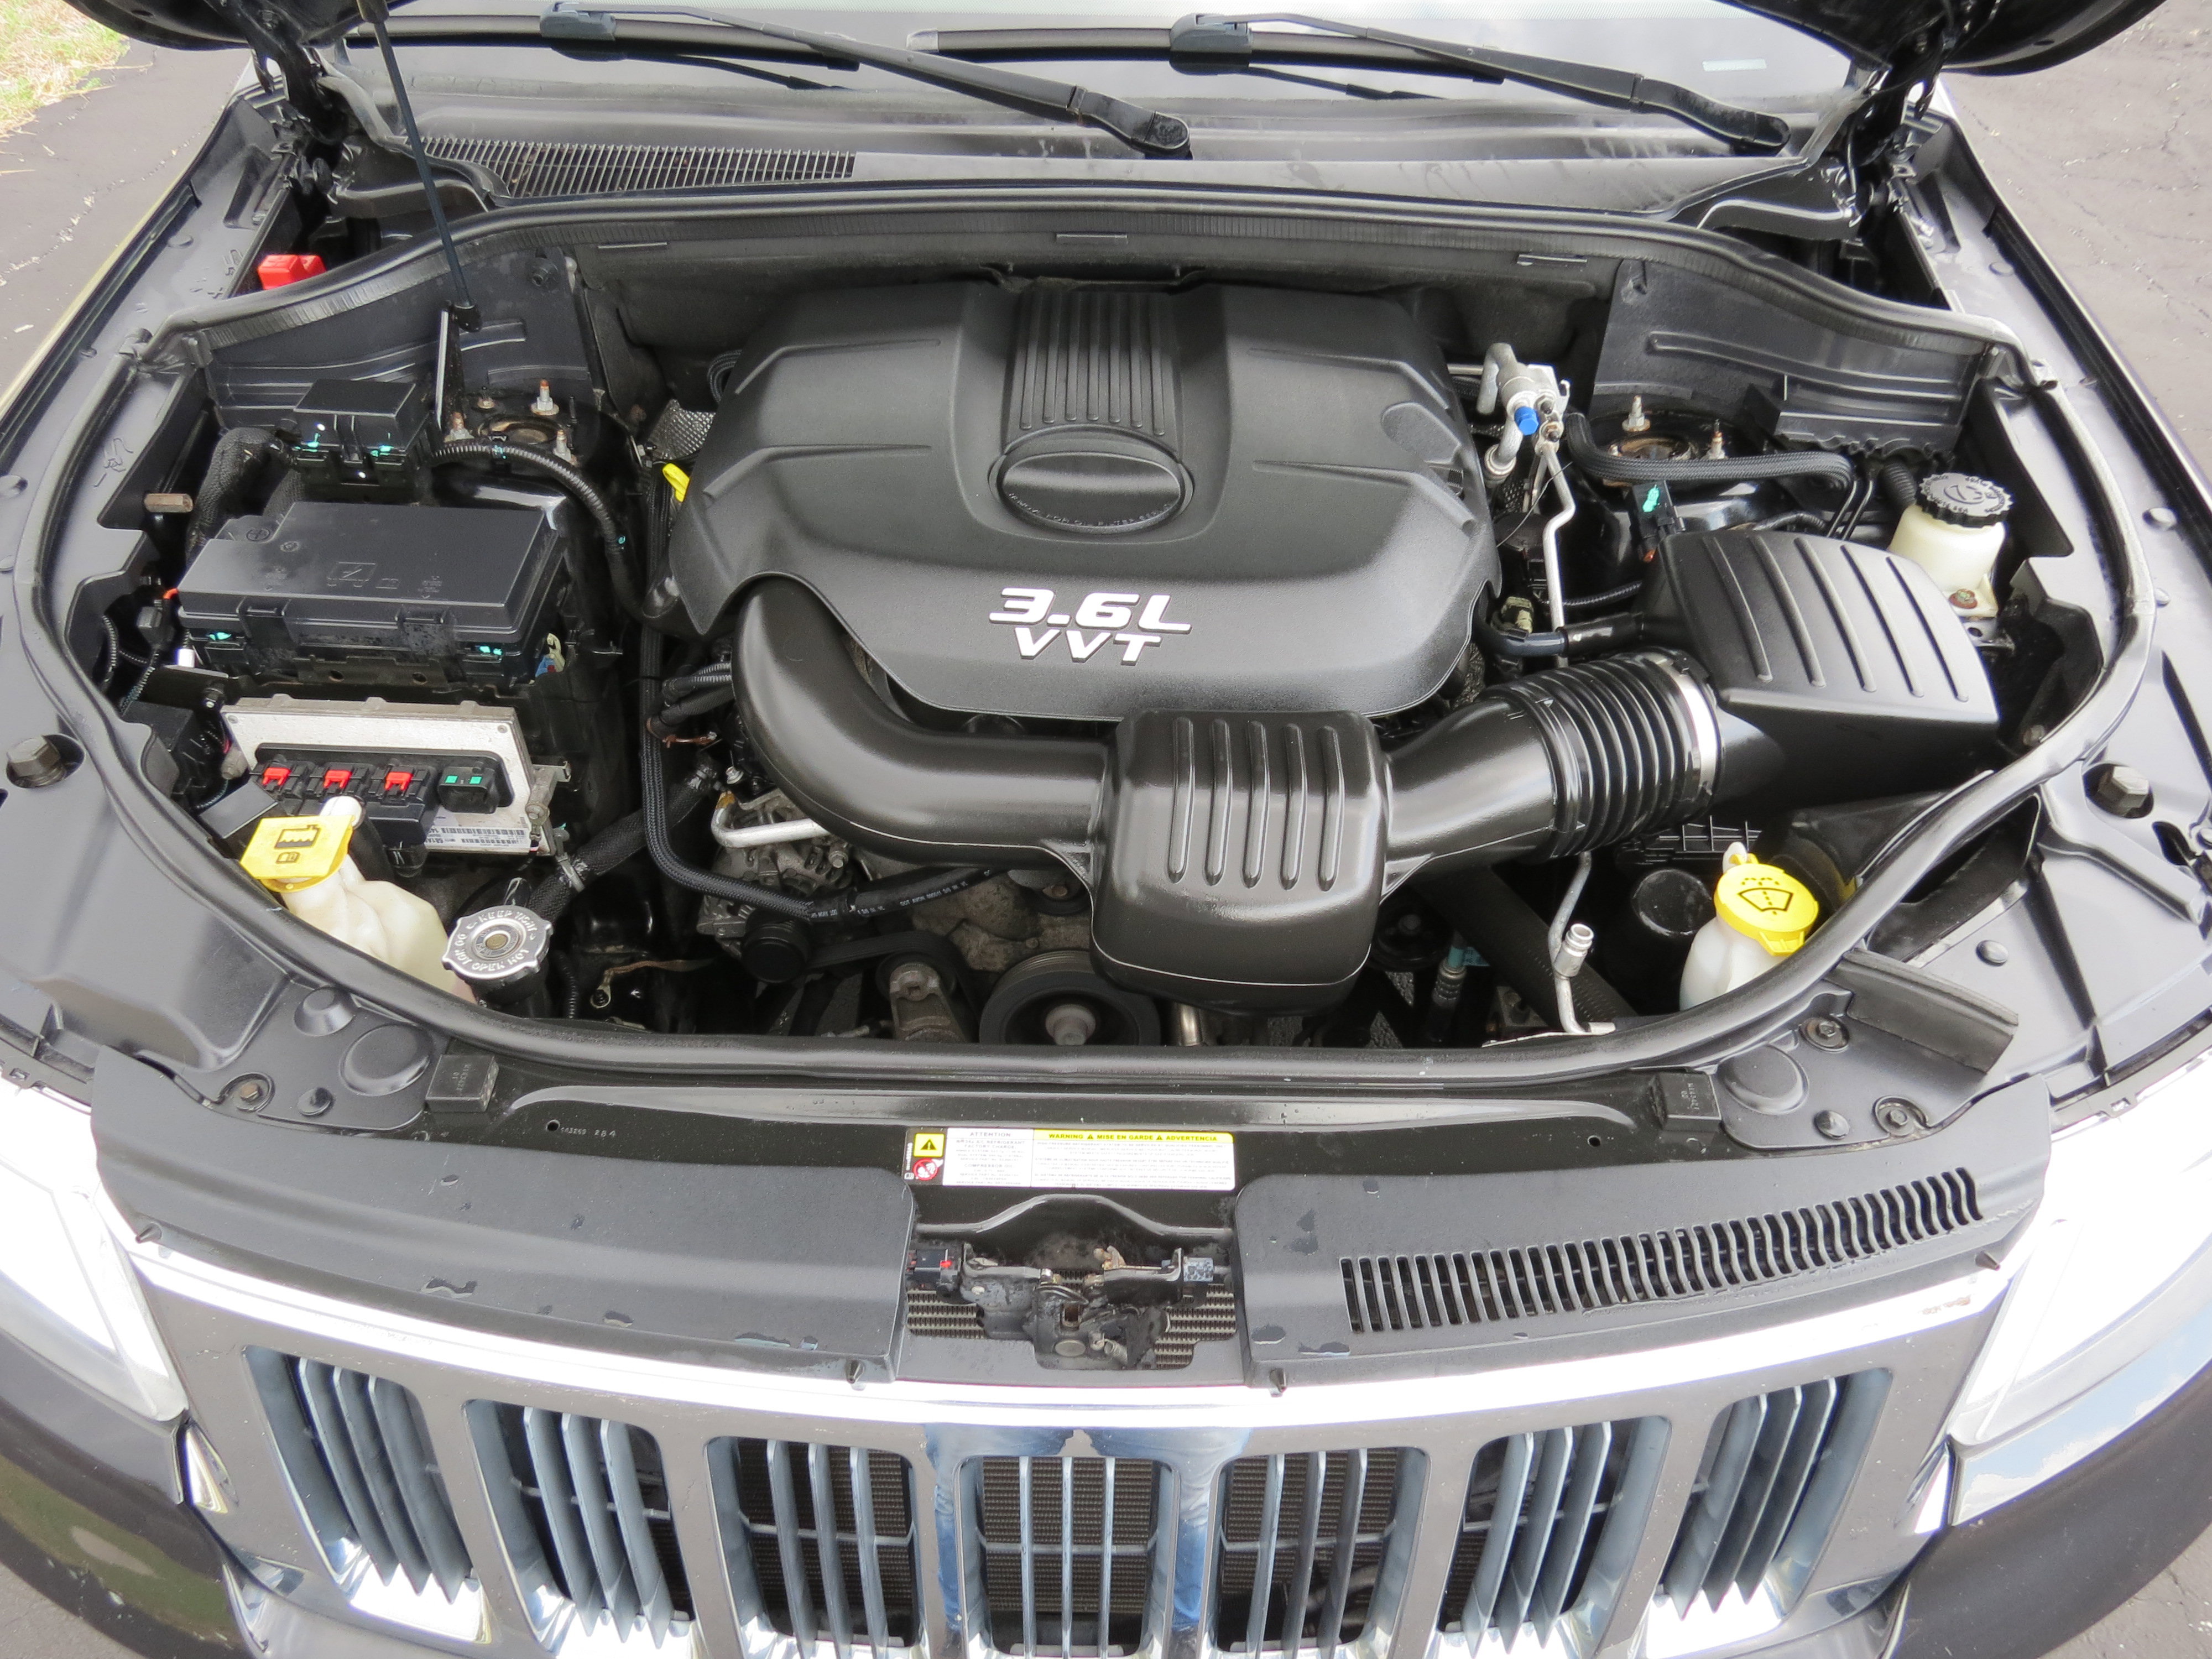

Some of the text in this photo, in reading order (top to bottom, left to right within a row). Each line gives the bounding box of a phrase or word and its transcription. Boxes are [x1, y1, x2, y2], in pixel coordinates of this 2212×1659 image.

[989, 587, 1192, 634] 3.6L
[1014, 627, 1162, 666] VVT
[478, 910, 513, 923] KEEP
[453, 948, 472, 965] NOT
[471, 962, 505, 972] OPEN
[507, 948, 530, 966] HOT
